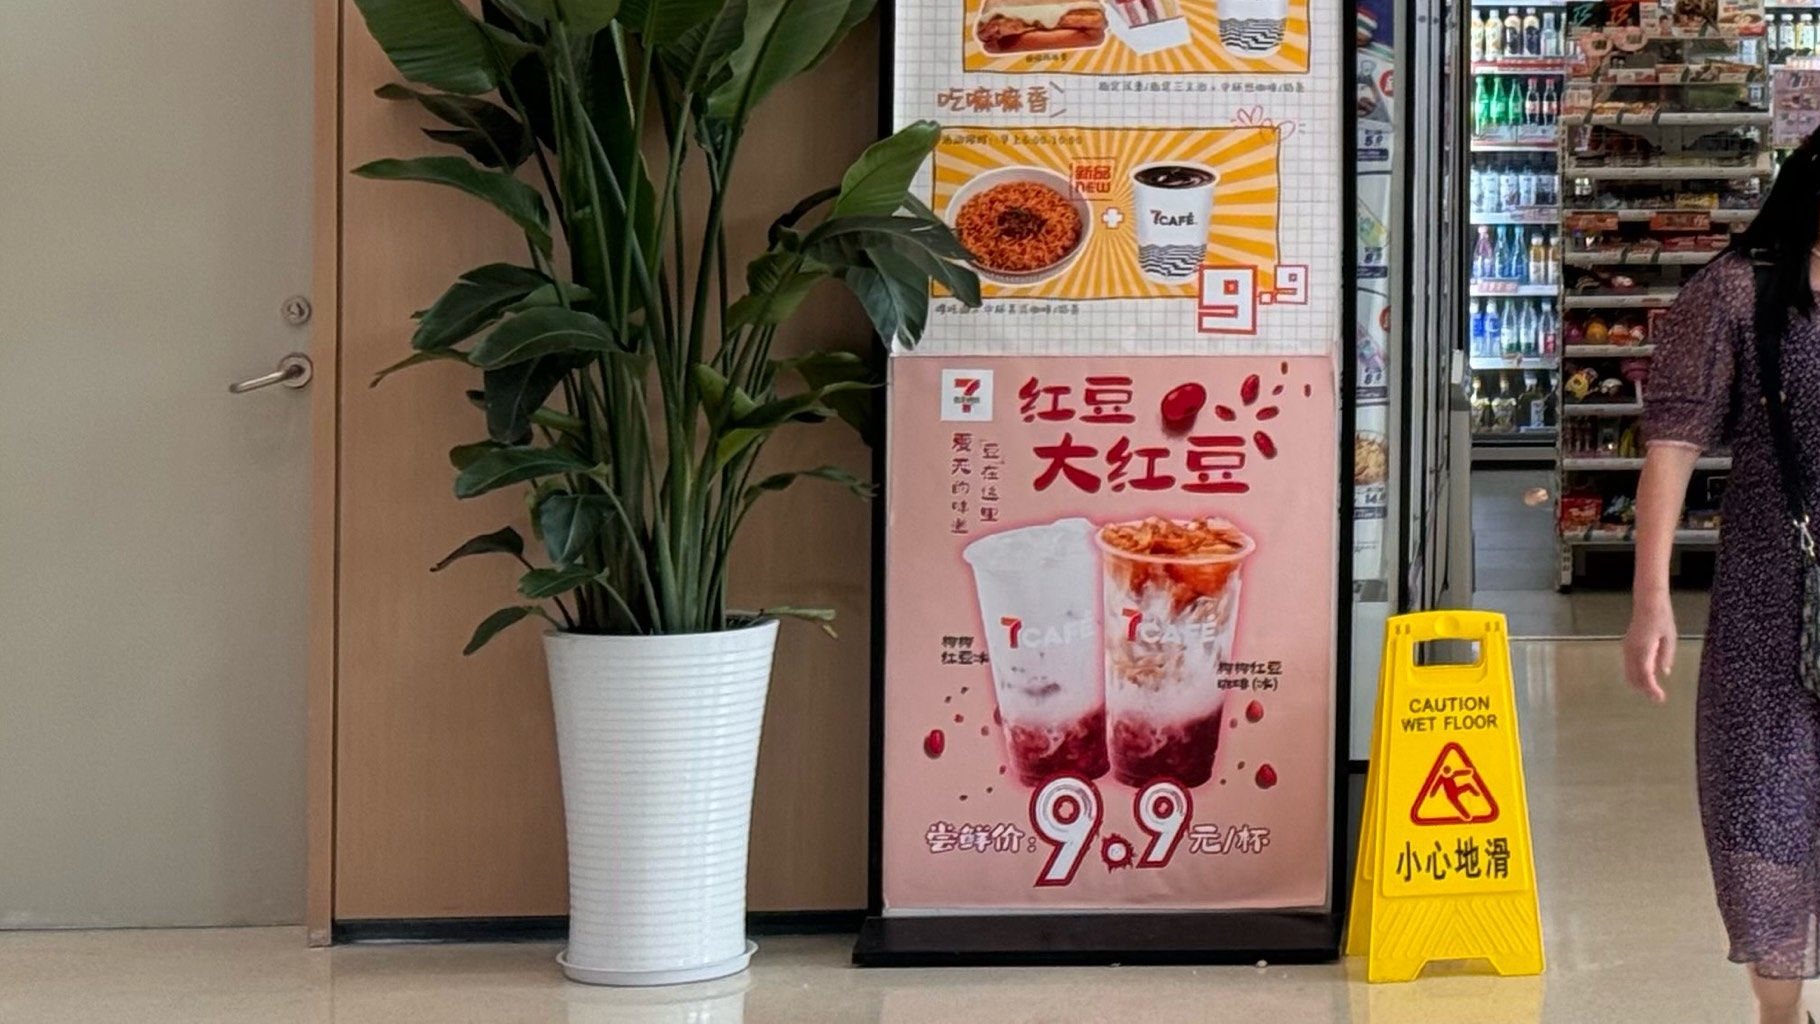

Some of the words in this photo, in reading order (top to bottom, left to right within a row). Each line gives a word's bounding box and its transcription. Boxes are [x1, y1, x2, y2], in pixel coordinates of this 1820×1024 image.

[937, 84, 1049, 114] 吃嘛嘛香
[1075, 165, 1112, 180] 新品
[1198, 264, 1308, 335] 9.9
[1019, 377, 1136, 423] 红豆
[1033, 433, 1251, 493] 大红豆
[1409, 696, 1490, 714] CAUTION
[1401, 717, 1436, 733] WET
[1444, 715, 1498, 731] FLOOR
[1396, 837, 1510, 881] 小心地滑
